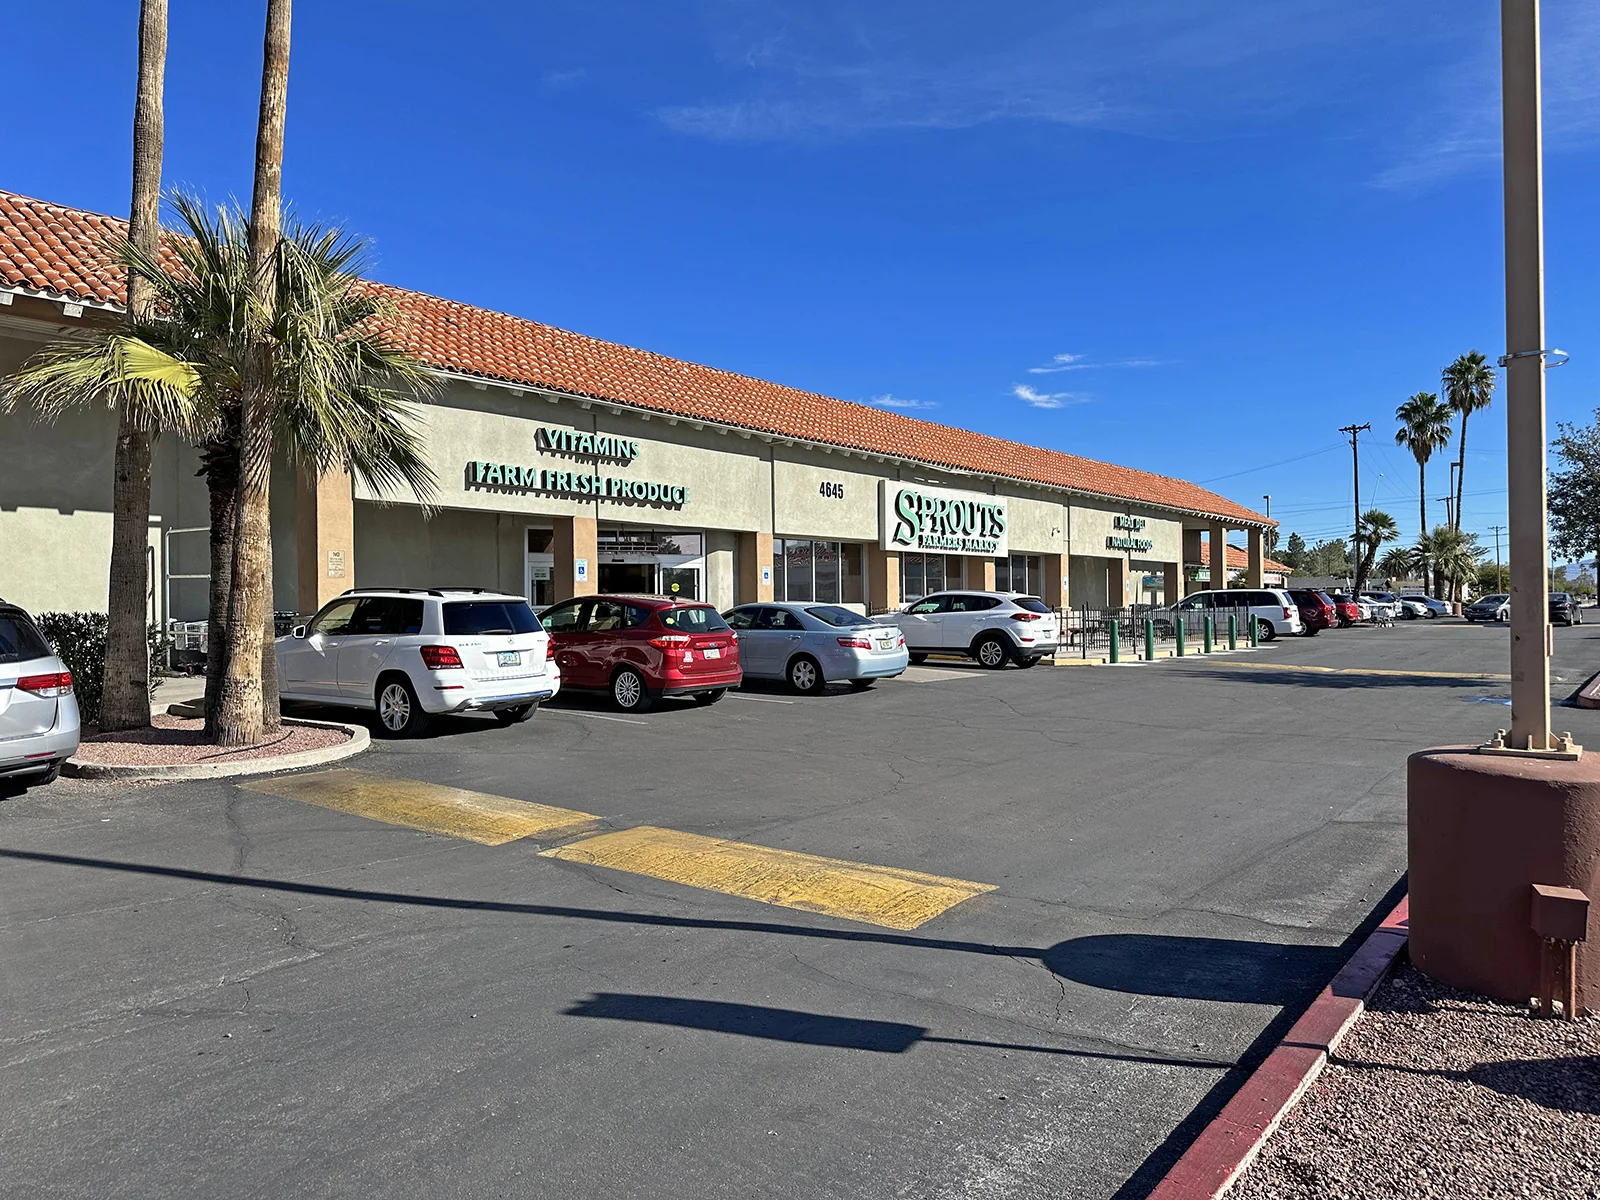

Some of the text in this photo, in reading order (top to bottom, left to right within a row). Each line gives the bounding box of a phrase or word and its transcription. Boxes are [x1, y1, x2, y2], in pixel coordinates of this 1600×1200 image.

[544, 427, 640, 460] VITAMINS
[474, 461, 691, 505] FARM FRESH PRODUCE
[819, 481, 844, 500] 4645
[892, 488, 1007, 546] SPROUTS
[921, 534, 1000, 552] FARMERS MARKET
